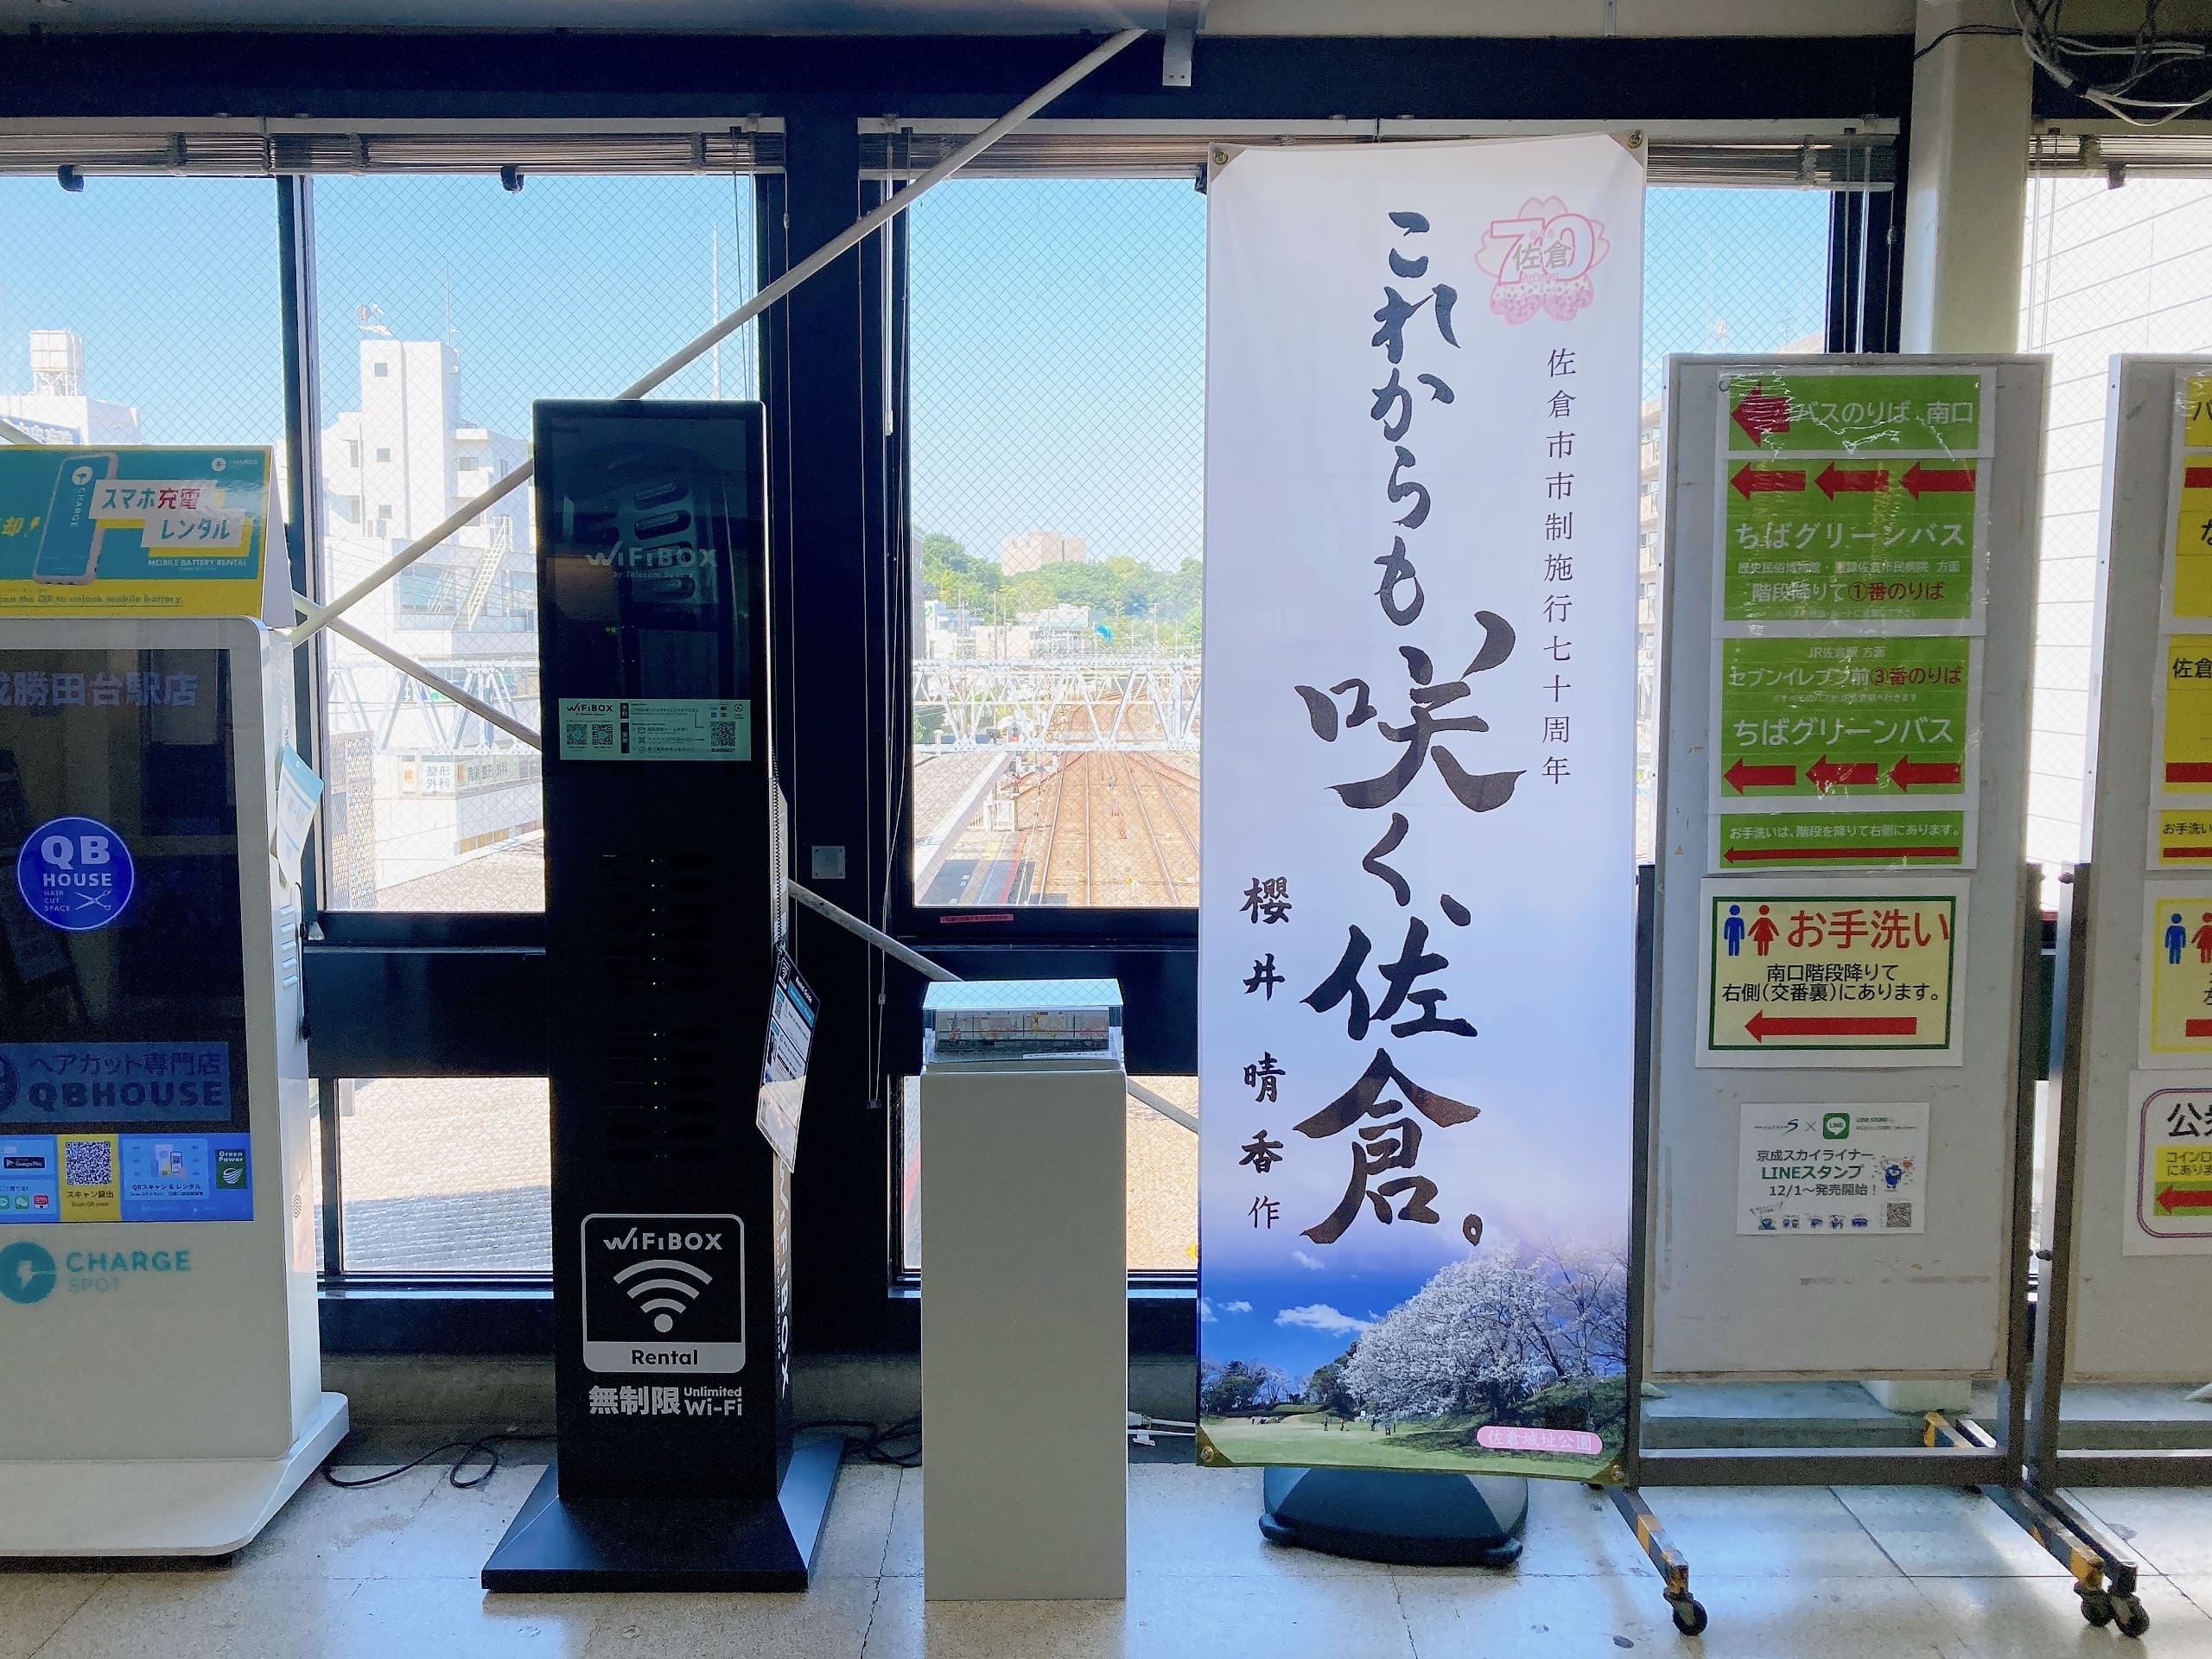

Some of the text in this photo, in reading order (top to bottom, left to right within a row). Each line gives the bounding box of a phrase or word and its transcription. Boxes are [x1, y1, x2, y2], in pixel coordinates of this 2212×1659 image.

[1512, 240, 1573, 271] 佐倉
[1927, 401, 1974, 424] 南口
[101, 486, 201, 511] スマホ充電
[161, 518, 231, 540] レンタル
[1735, 522, 1965, 550] ちばグリーンバス
[1541, 347, 1578, 785] 佐倉市市制施行七十周年
[1293, 211, 1527, 1247] これからも咲く、佐倉。
[1732, 716, 1954, 746] ちばグリーンバス
[1729, 823, 1962, 841] お手洗いは、階段を降りて右側にあります。
[41, 835, 111, 870] QB
[42, 872, 113, 887] HOUSE
[1787, 909, 1951, 950] お手洗い
[1767, 963, 1899, 982] 南口階段降りて
[1721, 983, 1940, 1003] 右側(交番裏)にあります。
[28, 1052, 222, 1076] ヘアカット専門店
[1757, 1148, 1874, 1162] 京成スカイライナー
[1762, 1163, 1866, 1180] LINEスタンプ
[65, 1250, 192, 1273] CHARGE
[67, 1276, 121, 1294] SPOT
[631, 1349, 699, 1366] Rental
[588, 1385, 681, 1415] 無制限
[683, 1386, 742, 1398] Unlimited
[683, 1398, 743, 1417] Wi-Fi
[1486, 1429, 1592, 1452] 佐倉城址公園
